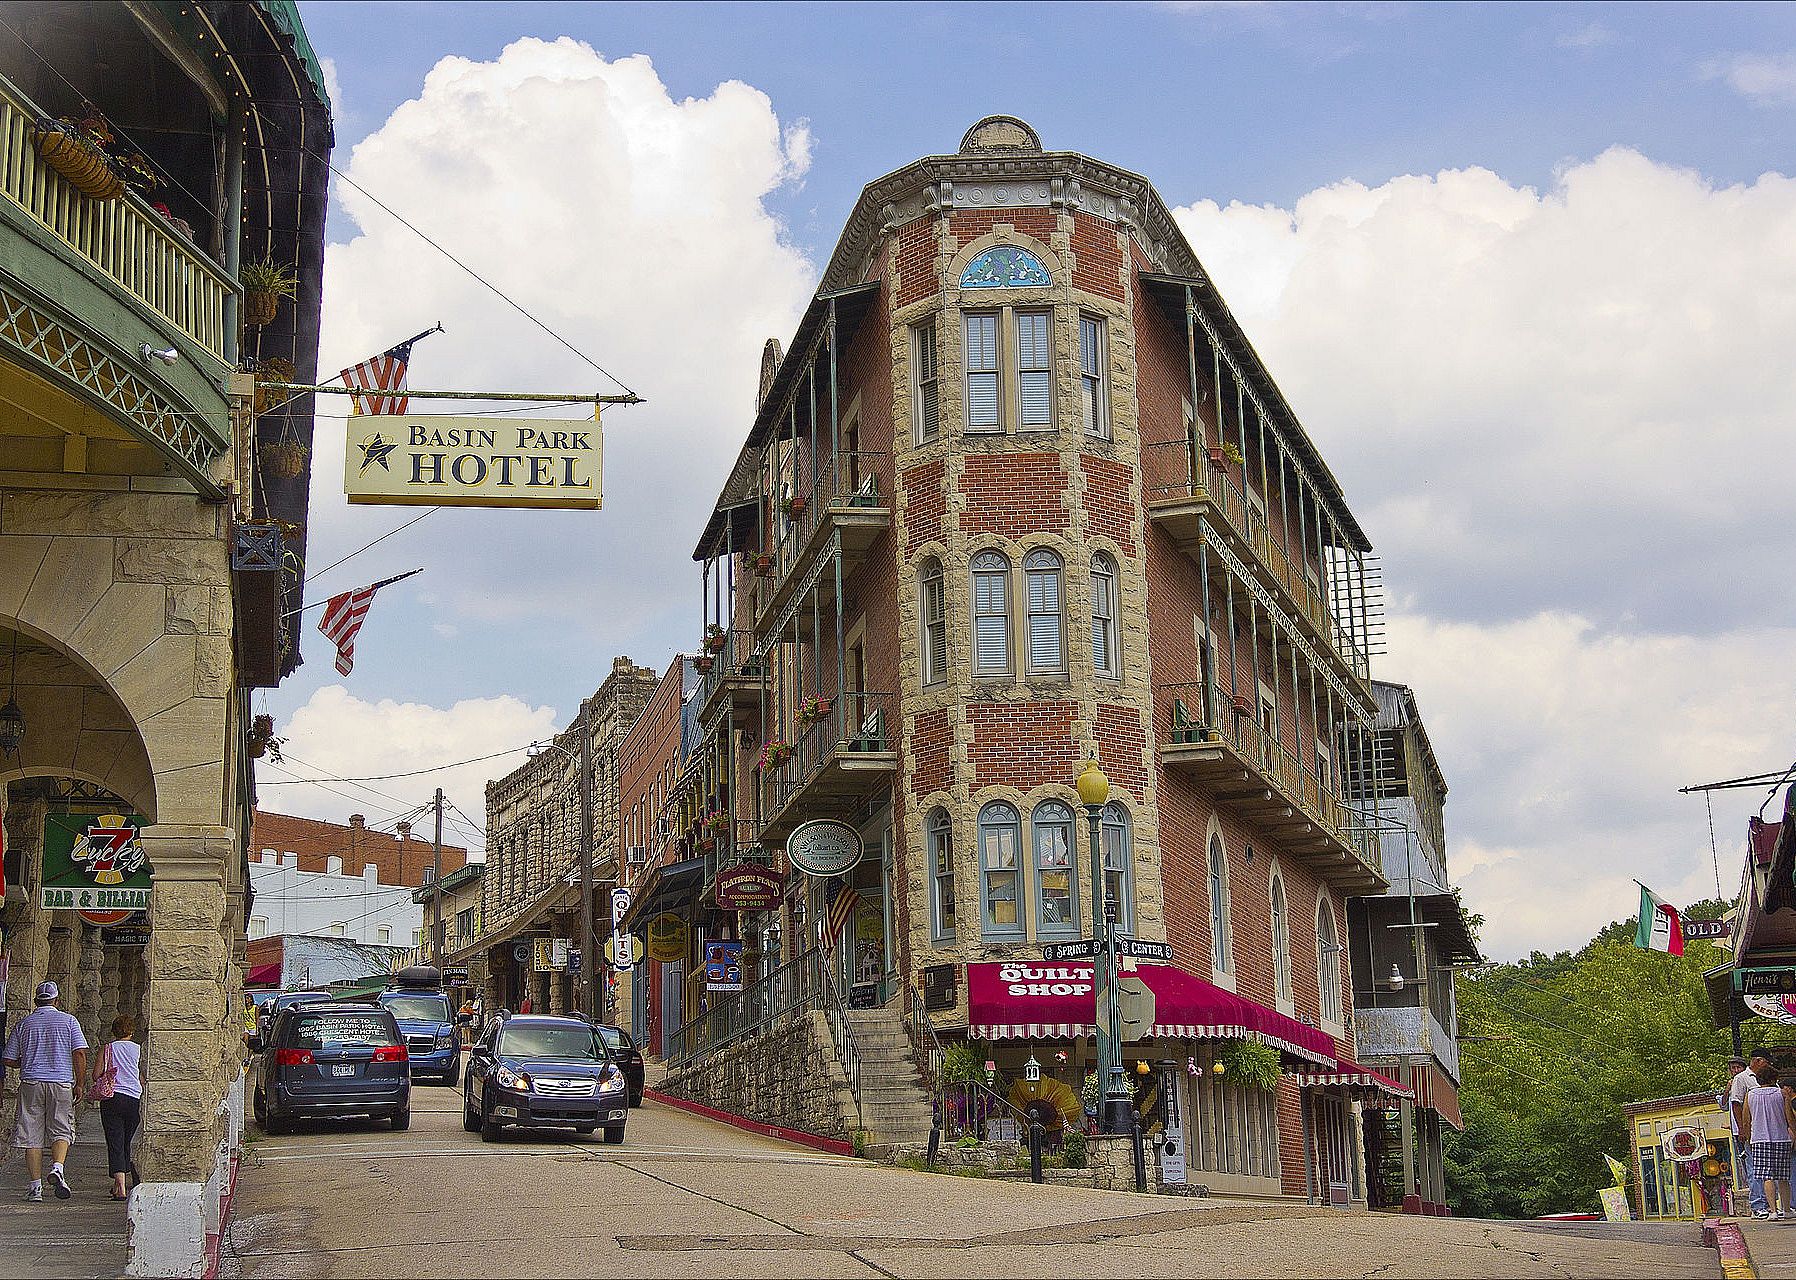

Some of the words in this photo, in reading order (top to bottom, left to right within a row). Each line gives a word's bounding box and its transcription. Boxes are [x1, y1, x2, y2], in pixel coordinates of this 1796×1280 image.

[408, 425, 498, 448] BASIN
[515, 427, 593, 450] PARK
[407, 452, 593, 489] HOTEL
[800, 833, 823, 850] WILSON
[826, 832, 850, 849] WILSON
[71, 836, 146, 873] Lucky
[720, 875, 755, 897] FLATIRON
[756, 875, 780, 897] FLATS
[44, 890, 74, 907] BAR
[78, 890, 92, 907] &
[1686, 922, 1722, 936] OLD
[1056, 943, 1089, 959] SPRING
[1131, 942, 1165, 957] CENTER
[999, 968, 1095, 983] QUILT
[1744, 972, 1779, 993] Henri's
[1008, 984, 1093, 997] SHOP
[313, 1018, 344, 1026] FOLLOW
[315, 1023, 338, 1031] BASIN
[361, 1023, 387, 1031] HOTEL
